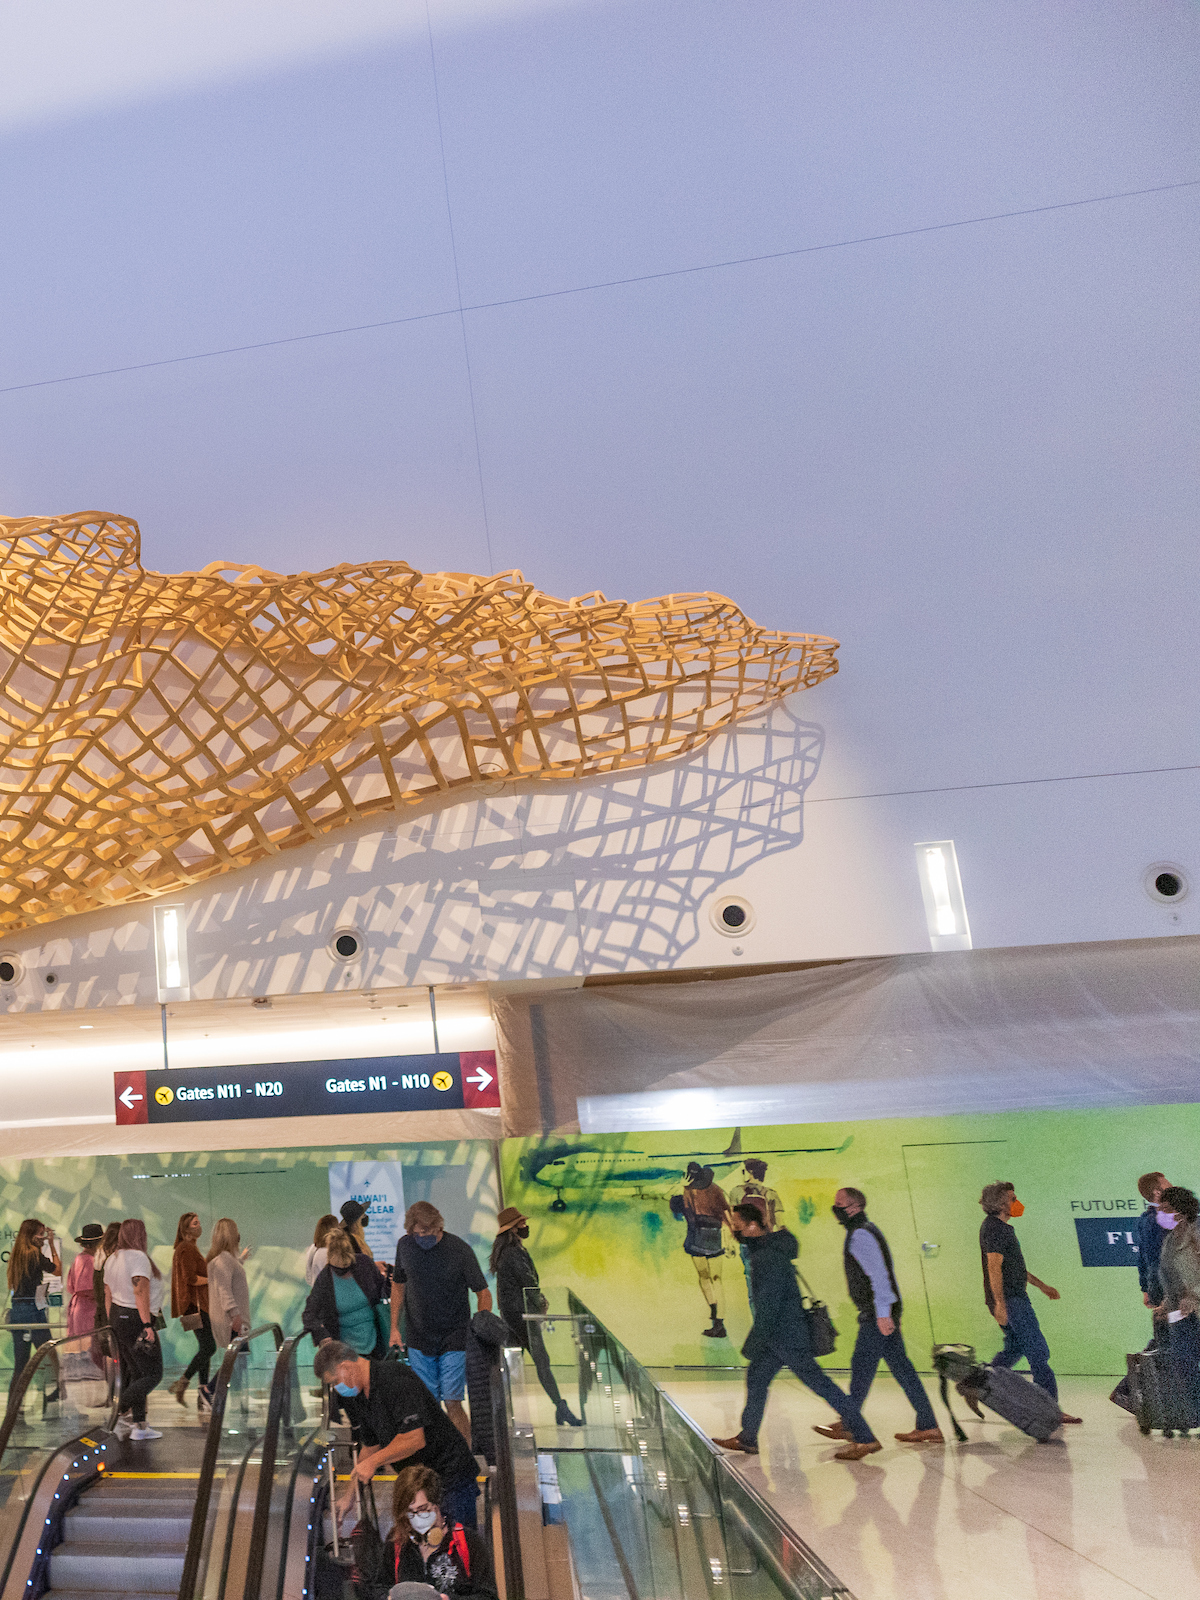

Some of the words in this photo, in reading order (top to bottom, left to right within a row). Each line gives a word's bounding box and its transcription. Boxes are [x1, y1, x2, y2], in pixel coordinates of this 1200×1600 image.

[176, 1085, 214, 1101] Gates
[217, 1084, 242, 1099] N11
[255, 1081, 283, 1097] N20
[325, 1077, 366, 1094] Gates
[368, 1076, 387, 1091] N1
[401, 1073, 430, 1090] N10
[1070, 1199, 1138, 1212] FUTURE
